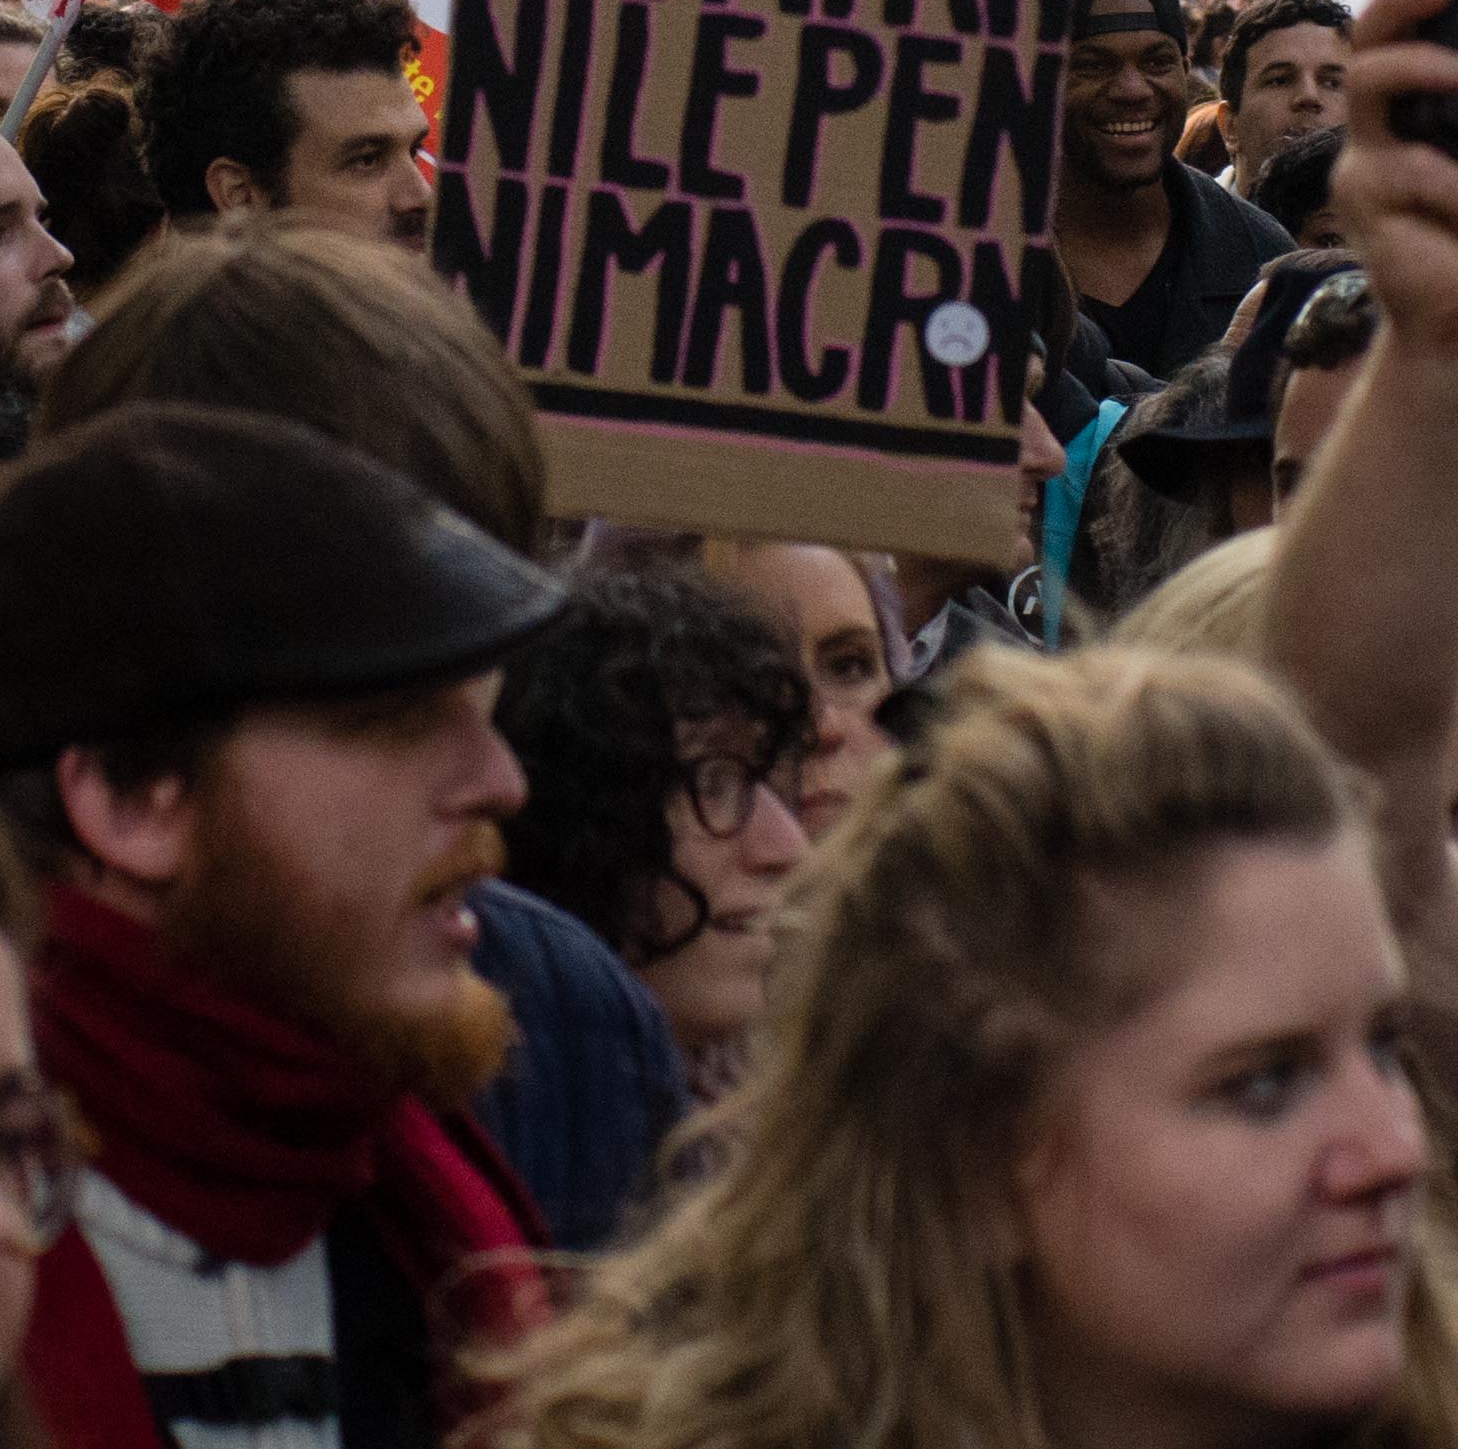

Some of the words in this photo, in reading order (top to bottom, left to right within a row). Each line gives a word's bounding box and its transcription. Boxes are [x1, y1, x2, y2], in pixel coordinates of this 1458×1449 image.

[600, 0, 769, 199] LE
[781, 22, 1067, 235] PEN
[430, 169, 568, 368] NI
